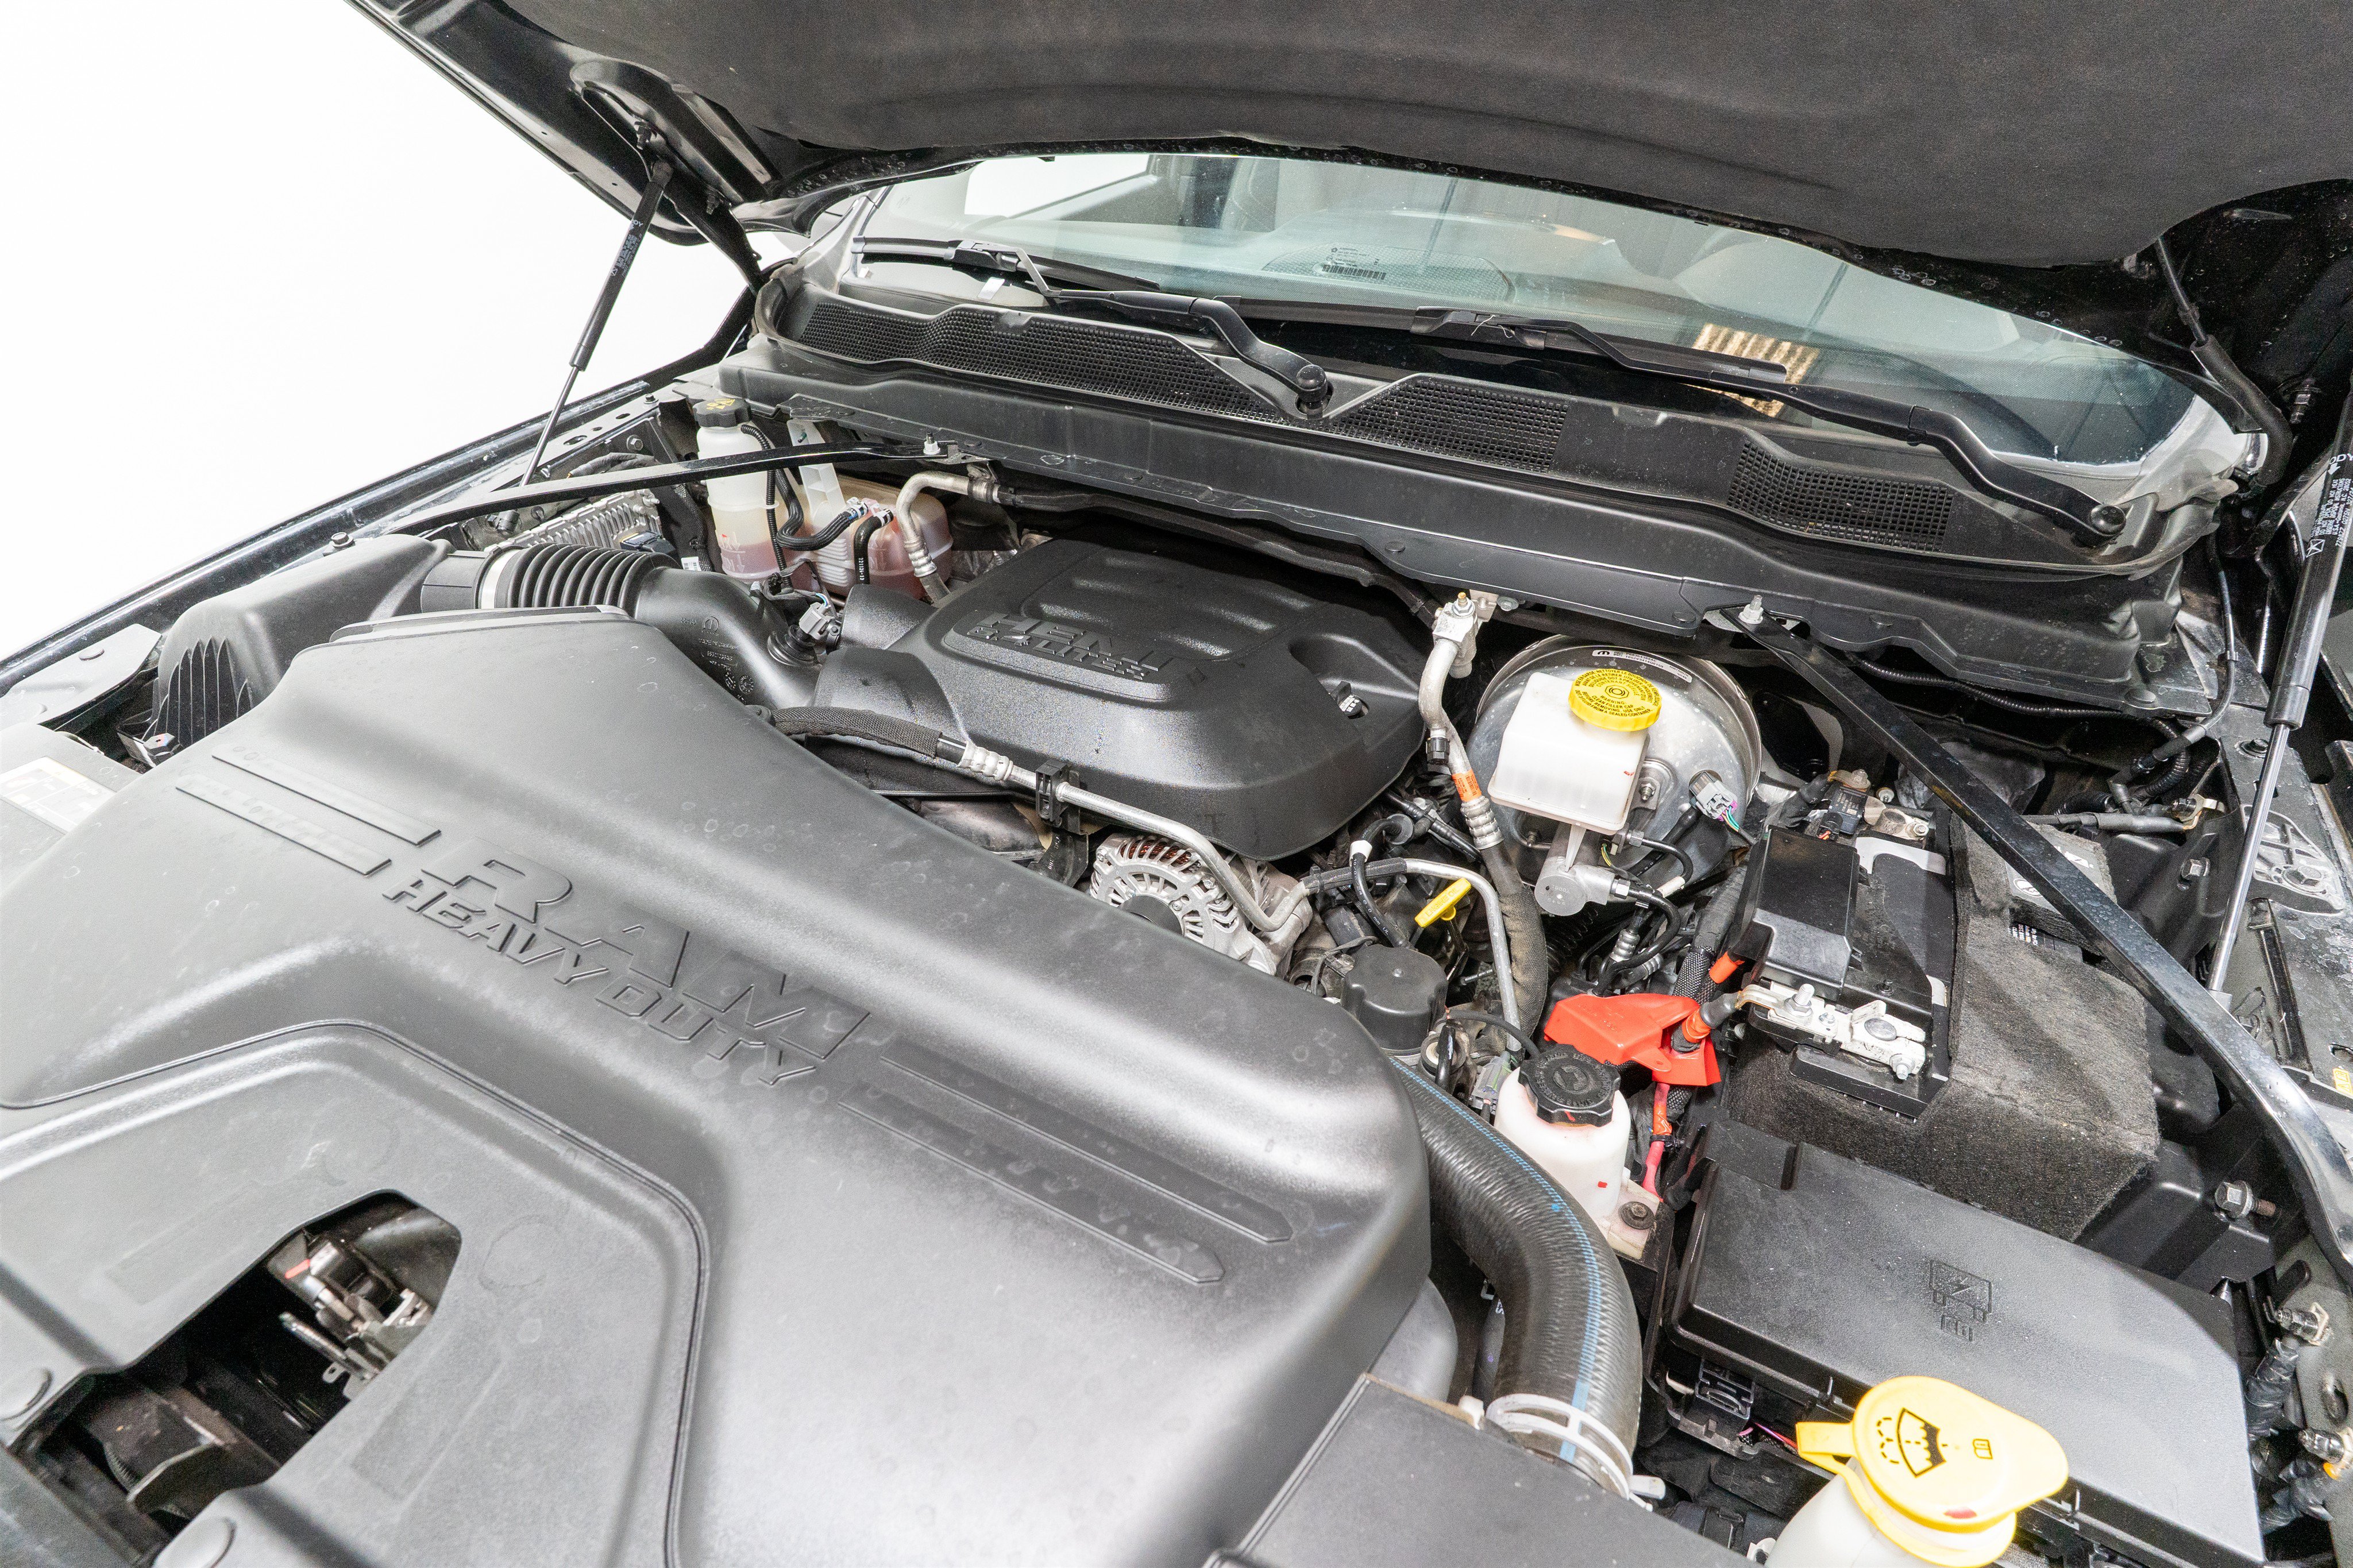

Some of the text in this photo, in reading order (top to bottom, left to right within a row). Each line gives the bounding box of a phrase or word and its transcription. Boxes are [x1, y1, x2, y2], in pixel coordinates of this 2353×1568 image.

[967, 627, 1032, 647] 6.4
[976, 612, 1174, 671] HEMI
[1581, 697, 1592, 706] FLUID
[1583, 691, 1595, 702] BEFORE
[1592, 696, 1606, 705] CLEAN
[1382, 926, 1390, 936] UL
[422, 837, 871, 1059] RAM
[382, 879, 816, 1086] HEAVY DUTY
